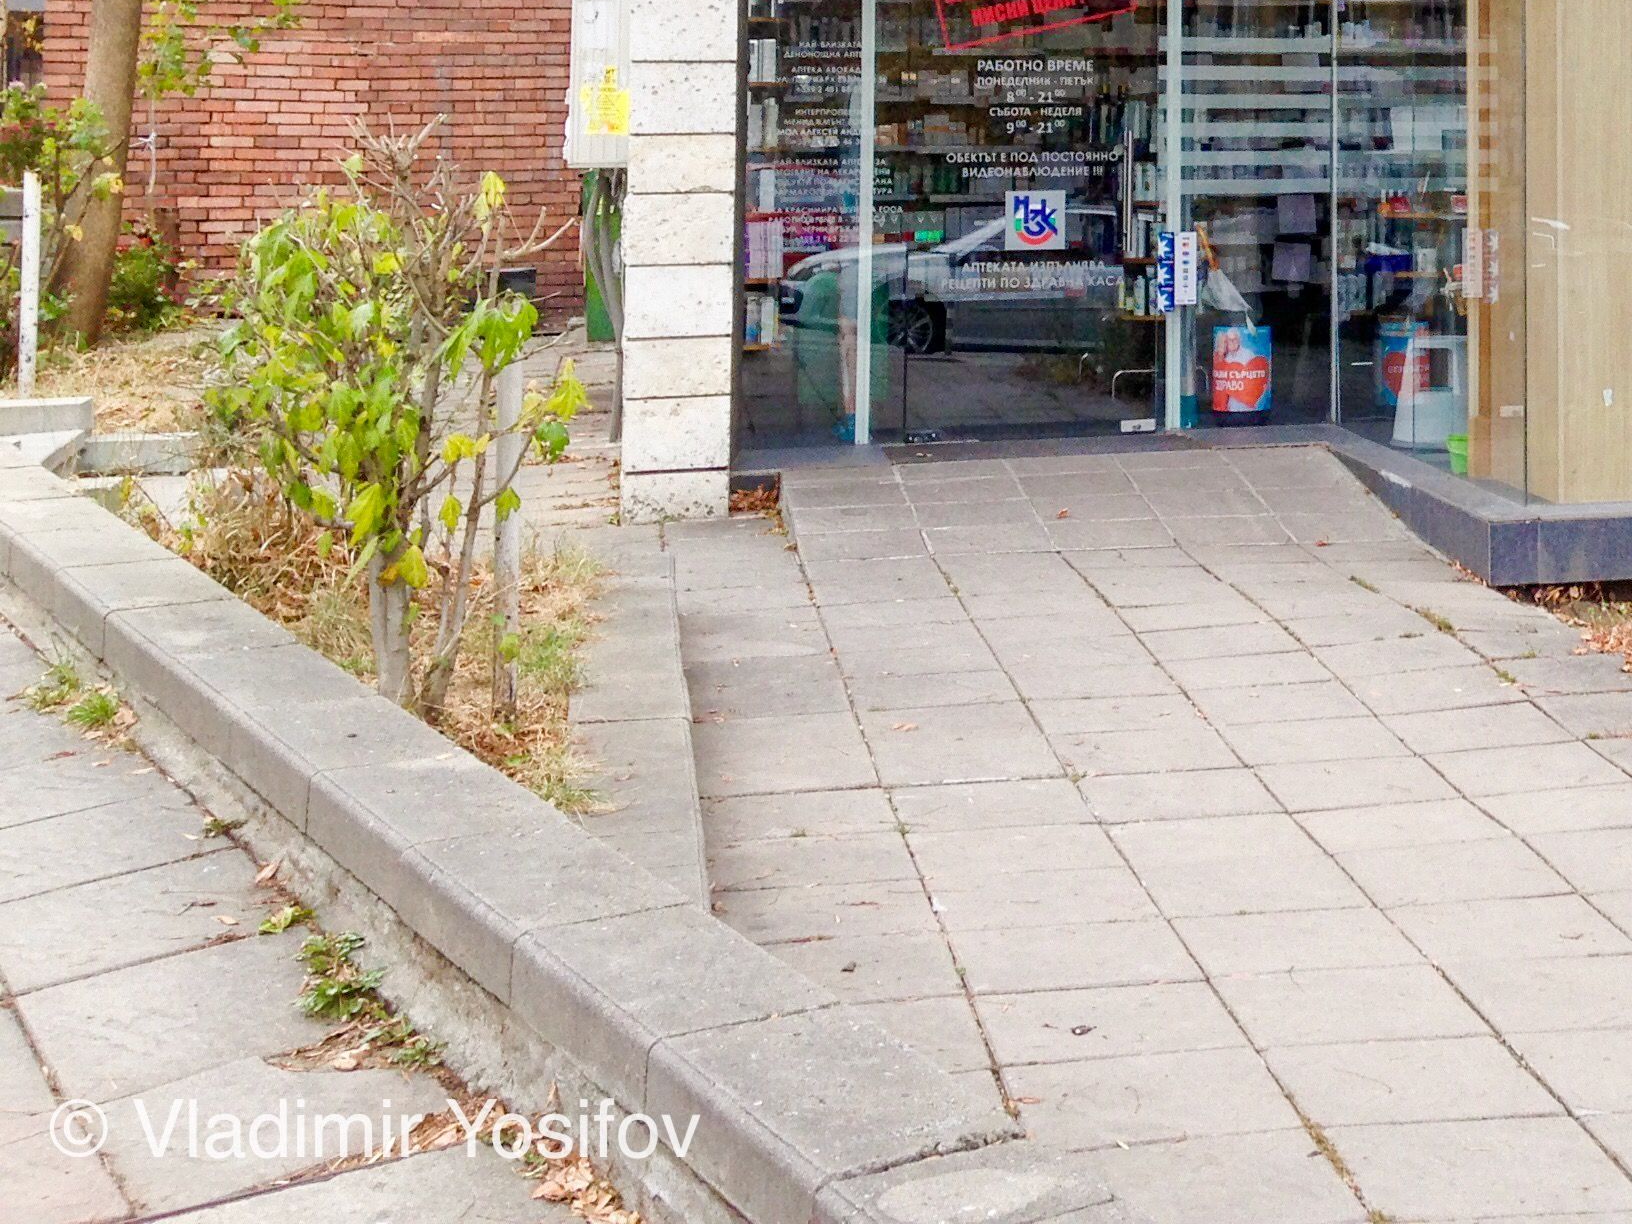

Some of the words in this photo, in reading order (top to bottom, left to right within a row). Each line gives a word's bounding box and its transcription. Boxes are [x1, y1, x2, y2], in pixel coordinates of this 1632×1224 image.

[977, 59, 1043, 71] РАБОТНО
[1047, 59, 1095, 71] ВРЕМЕ
[977, 76, 1051, 86] ПОНЕДЕЛНИК
[1060, 76, 1095, 86] ПЕТЪК
[989, 107, 1031, 116] СЪБОТА
[1040, 107, 1082, 117] НЕДЕЛЯ
[946, 152, 996, 163] ОБЕКТЪТ
[1000, 152, 1007, 162] Е
[1010, 151, 1038, 163] ПОД
[1041, 151, 1119, 162] ПОСТОЯННО
[962, 166, 1090, 178] ВИДЕОНАБЛЮДЕНИЕ
[961, 261, 1025, 273] АПТЕКАТА
[1029, 260, 1104, 272] ИЗПЪЛНЯВА
[942, 277, 996, 290] РЕЦЕПТИ
[1000, 277, 1020, 289] ПО
